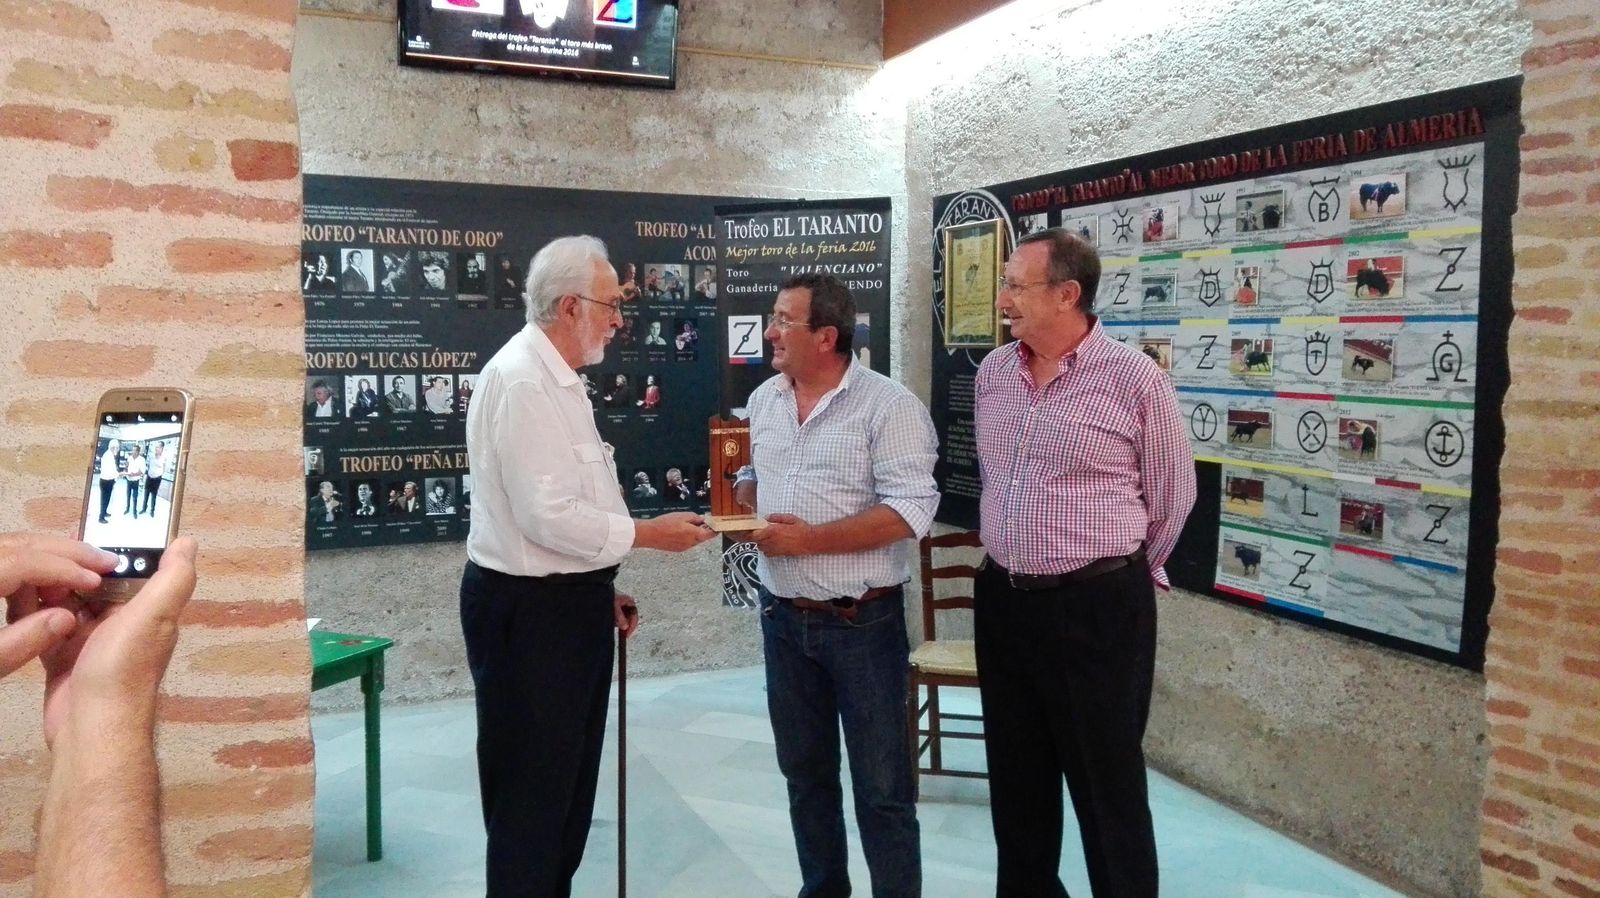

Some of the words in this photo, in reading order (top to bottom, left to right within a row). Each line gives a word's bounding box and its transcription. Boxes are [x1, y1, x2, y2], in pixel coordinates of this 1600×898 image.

[471, 29, 497, 41] Entrega
[497, 32, 508, 41] del
[508, 33, 528, 43] trofeo
[529, 35, 559, 45] "Taranto"
[560, 39, 567, 47] al
[567, 39, 580, 48] toro
[581, 40, 594, 49] más
[594, 41, 613, 51] bravo
[506, 43, 515, 51] de
[515, 43, 522, 51] la
[522, 44, 539, 53] Feria
[540, 46, 563, 55] Taurina
[563, 48, 579, 57] 2016
[1199, 153, 1238, 182] TORO
[1263, 144, 1288, 169] LA
[1293, 134, 1348, 166] FERIA
[1354, 127, 1377, 155] DE
[1385, 107, 1485, 150] ALMERIA
[945, 198, 999, 227] TARANT
[302, 223, 355, 243] ROFEO
[442, 229, 461, 247] DE
[635, 220, 688, 239] TROFEO
[724, 218, 769, 240] Trofeo
[773, 217, 795, 237] EL
[798, 212, 883, 236] TARANTO
[725, 245, 759, 264] Mejor
[761, 244, 783, 257] toro
[785, 242, 798, 259] de
[800, 242, 815, 255] la
[815, 240, 847, 262] feria
[849, 240, 876, 253] 2016
[726, 268, 750, 278] Toro
[305, 352, 357, 369] ROFEO
[340, 455, 403, 473] TROFEO
